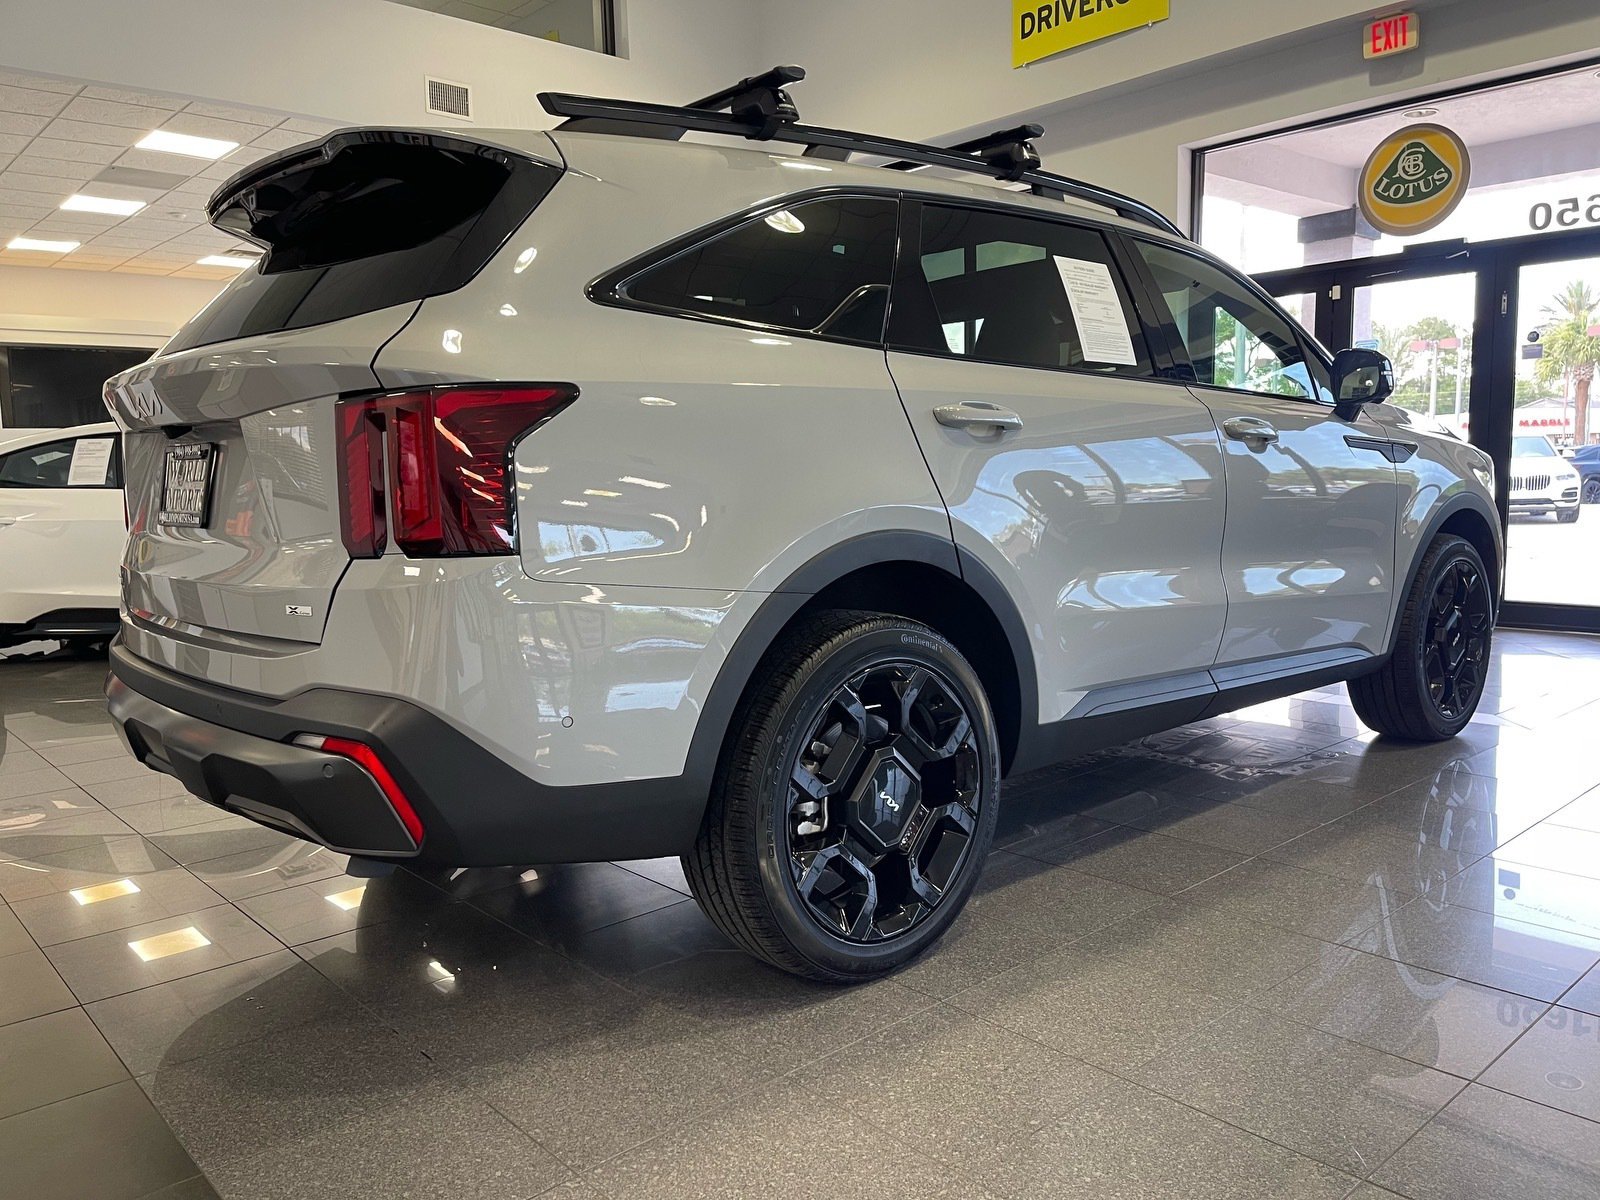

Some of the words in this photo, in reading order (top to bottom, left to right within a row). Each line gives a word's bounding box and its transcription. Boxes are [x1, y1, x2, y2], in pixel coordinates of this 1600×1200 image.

[1020, 0, 1129, 40] DRIVER
[1371, 15, 1408, 54] EXIT
[1375, 167, 1449, 199] LOTUS
[900, 633, 938, 652] Continental
